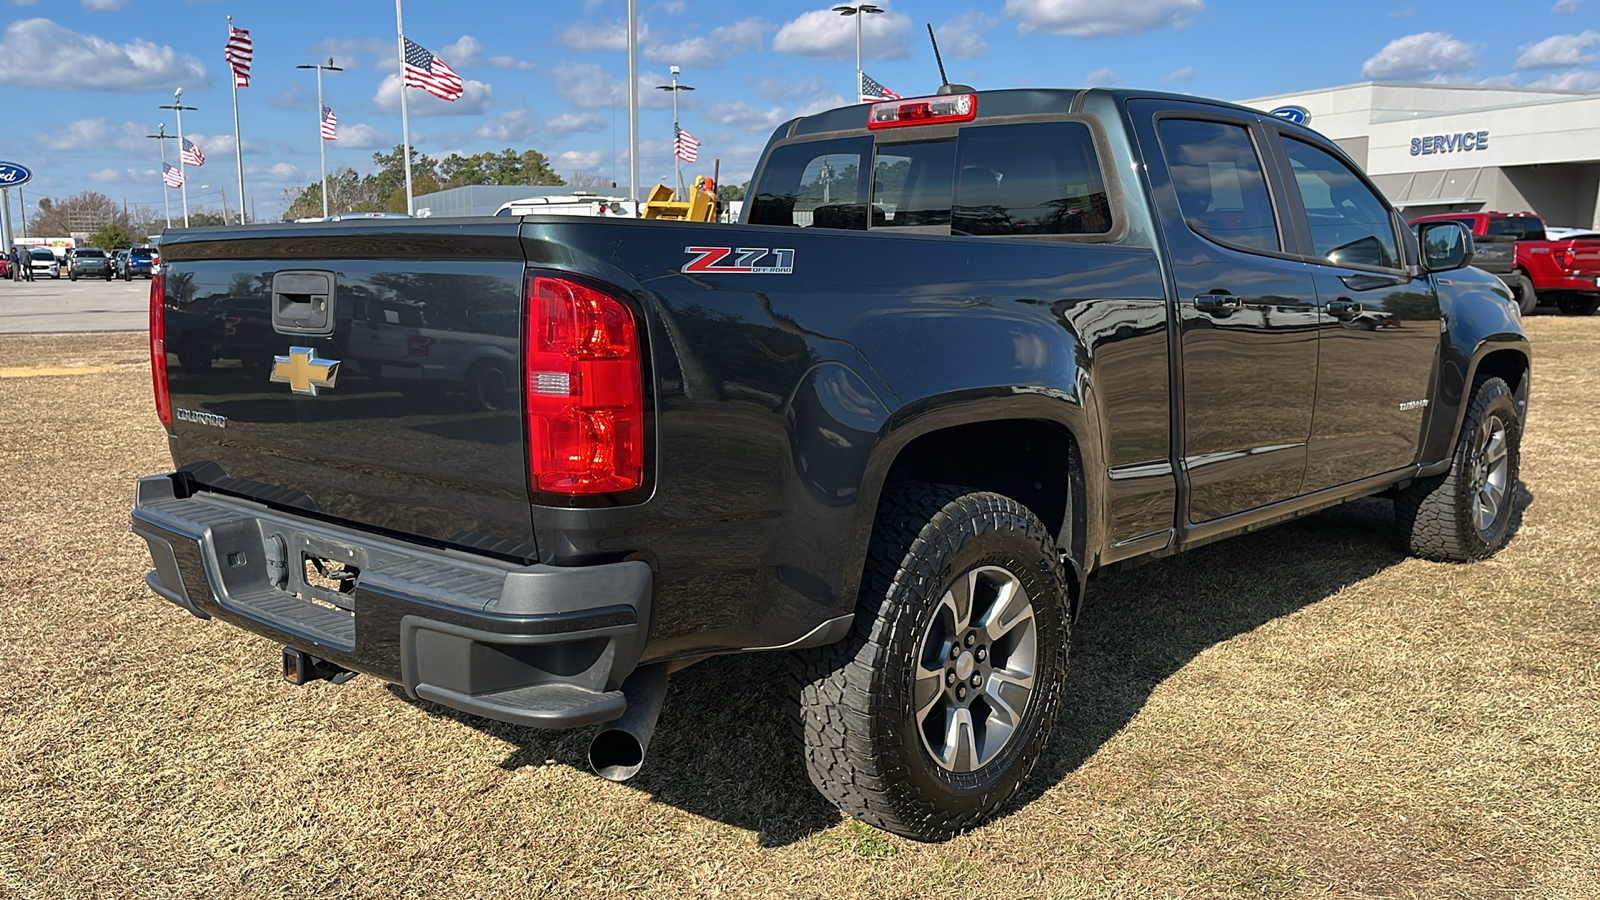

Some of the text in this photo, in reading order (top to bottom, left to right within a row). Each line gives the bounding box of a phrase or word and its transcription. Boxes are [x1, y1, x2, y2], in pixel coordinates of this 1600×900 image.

[1410, 130, 1488, 156] SERVICE
[0, 166, 17, 181] rd
[681, 246, 795, 274] Z71
[176, 408, 226, 428] COLORADO
